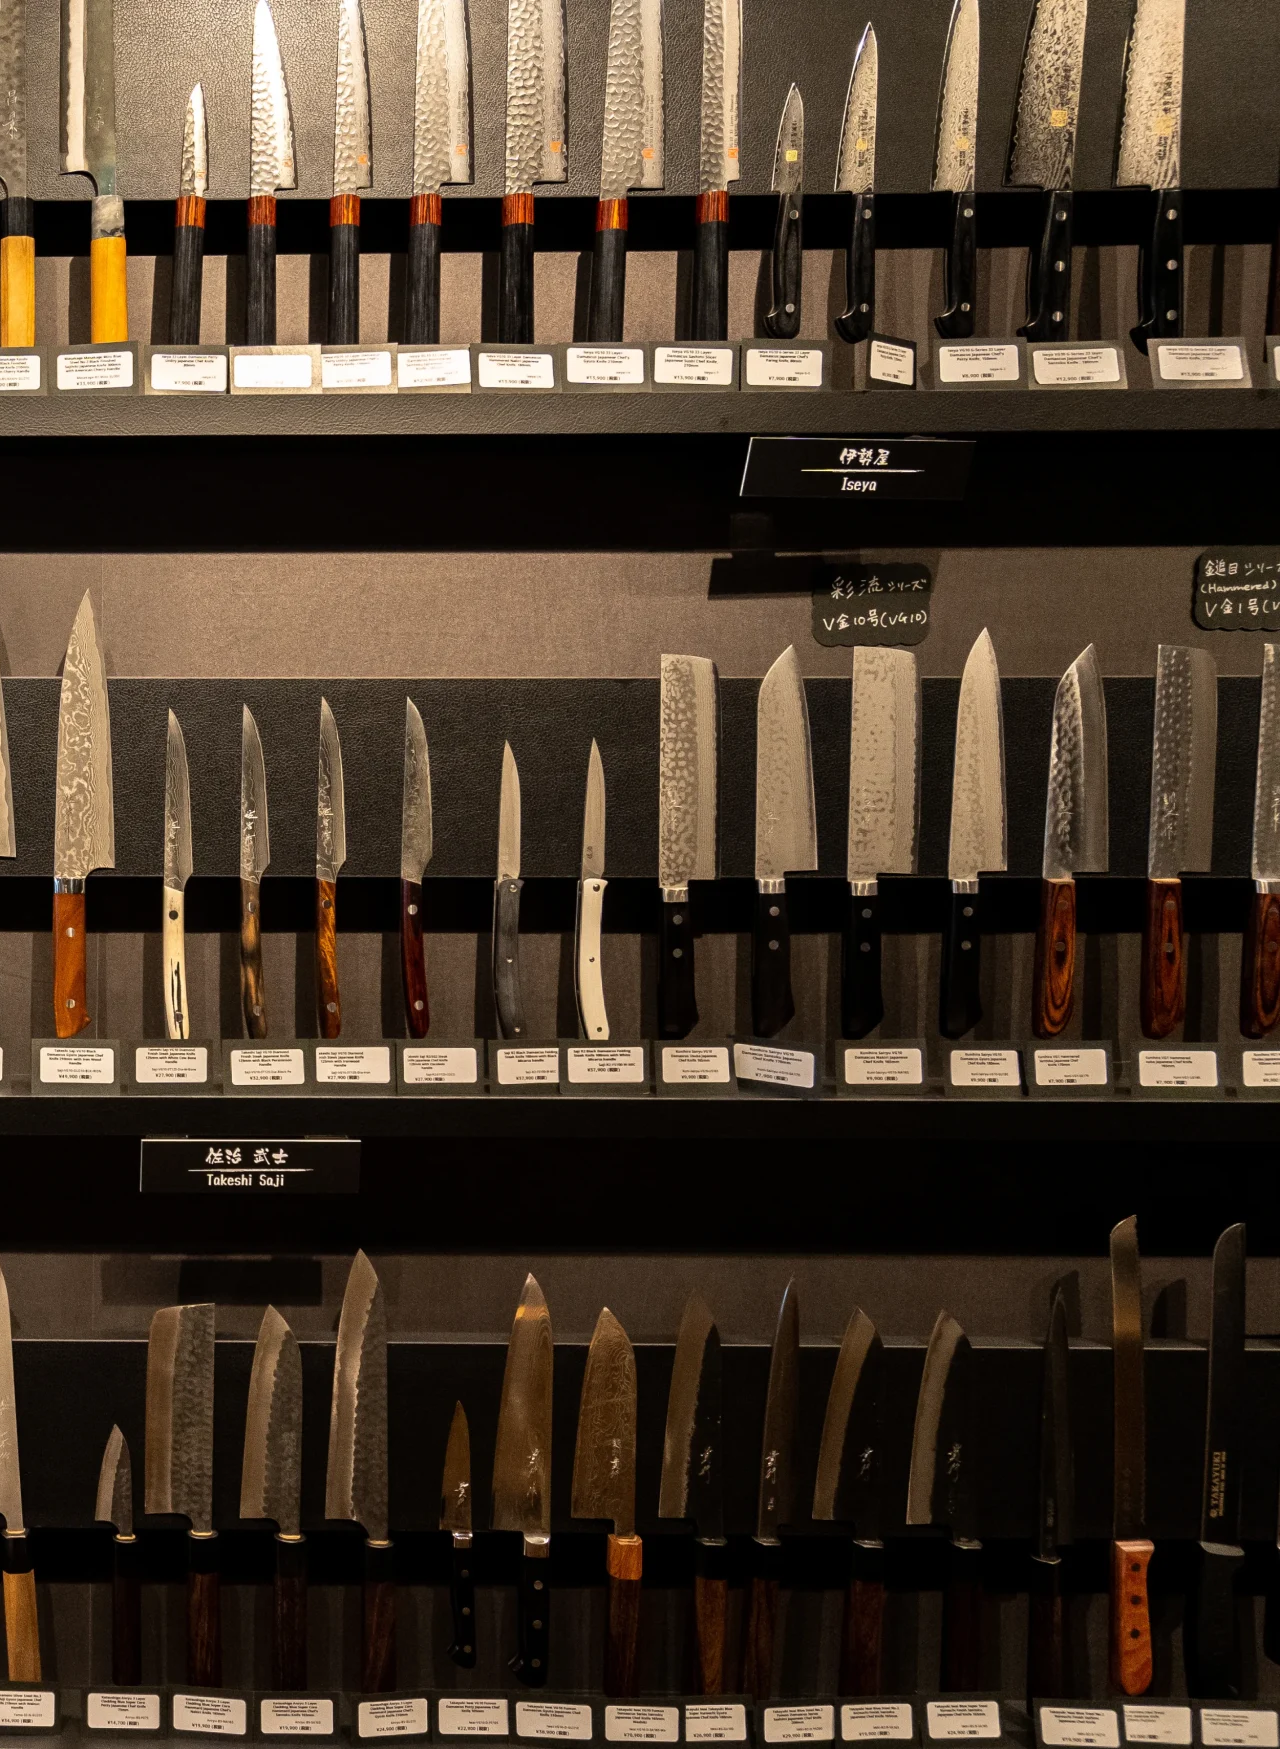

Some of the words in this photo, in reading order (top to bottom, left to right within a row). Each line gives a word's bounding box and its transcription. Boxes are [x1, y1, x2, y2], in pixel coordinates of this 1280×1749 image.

[839, 447, 890, 466] 伊勢屋
[841, 477, 877, 492] Iseya
[1200, 579, 1277, 594] (Hammered)
[204, 1147, 242, 1165] 佐治
[253, 1147, 289, 1165] 武士
[206, 1174, 253, 1186] Takeshi
[259, 1174, 285, 1188] Saji
[1210, 1450, 1222, 1506] TAKAYUKI
